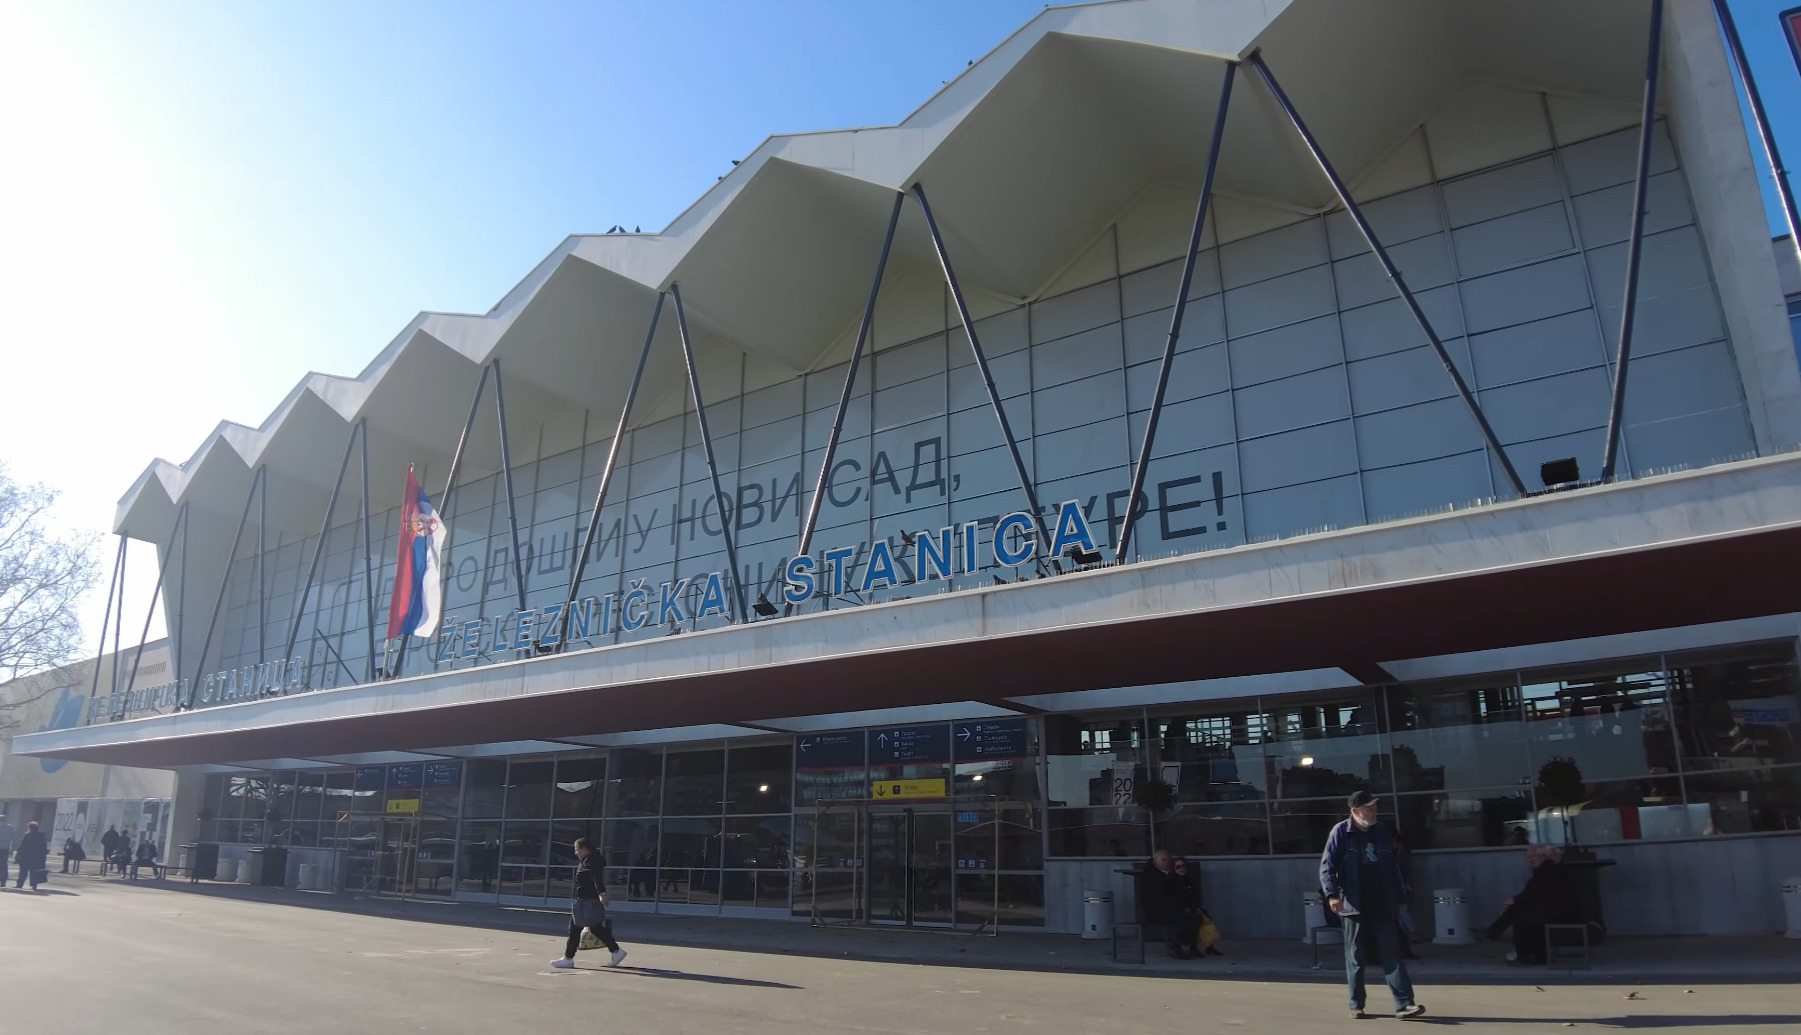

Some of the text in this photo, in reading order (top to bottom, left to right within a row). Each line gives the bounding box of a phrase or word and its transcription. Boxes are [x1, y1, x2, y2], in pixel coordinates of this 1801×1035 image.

[668, 470, 800, 546] НОВИ
[825, 436, 962, 508] САД,
[436, 498, 1098, 665] ŽELEZNIČKA STANICA
[203, 655, 302, 704] СТАНИЦА
[1114, 777, 1133, 792] 20
